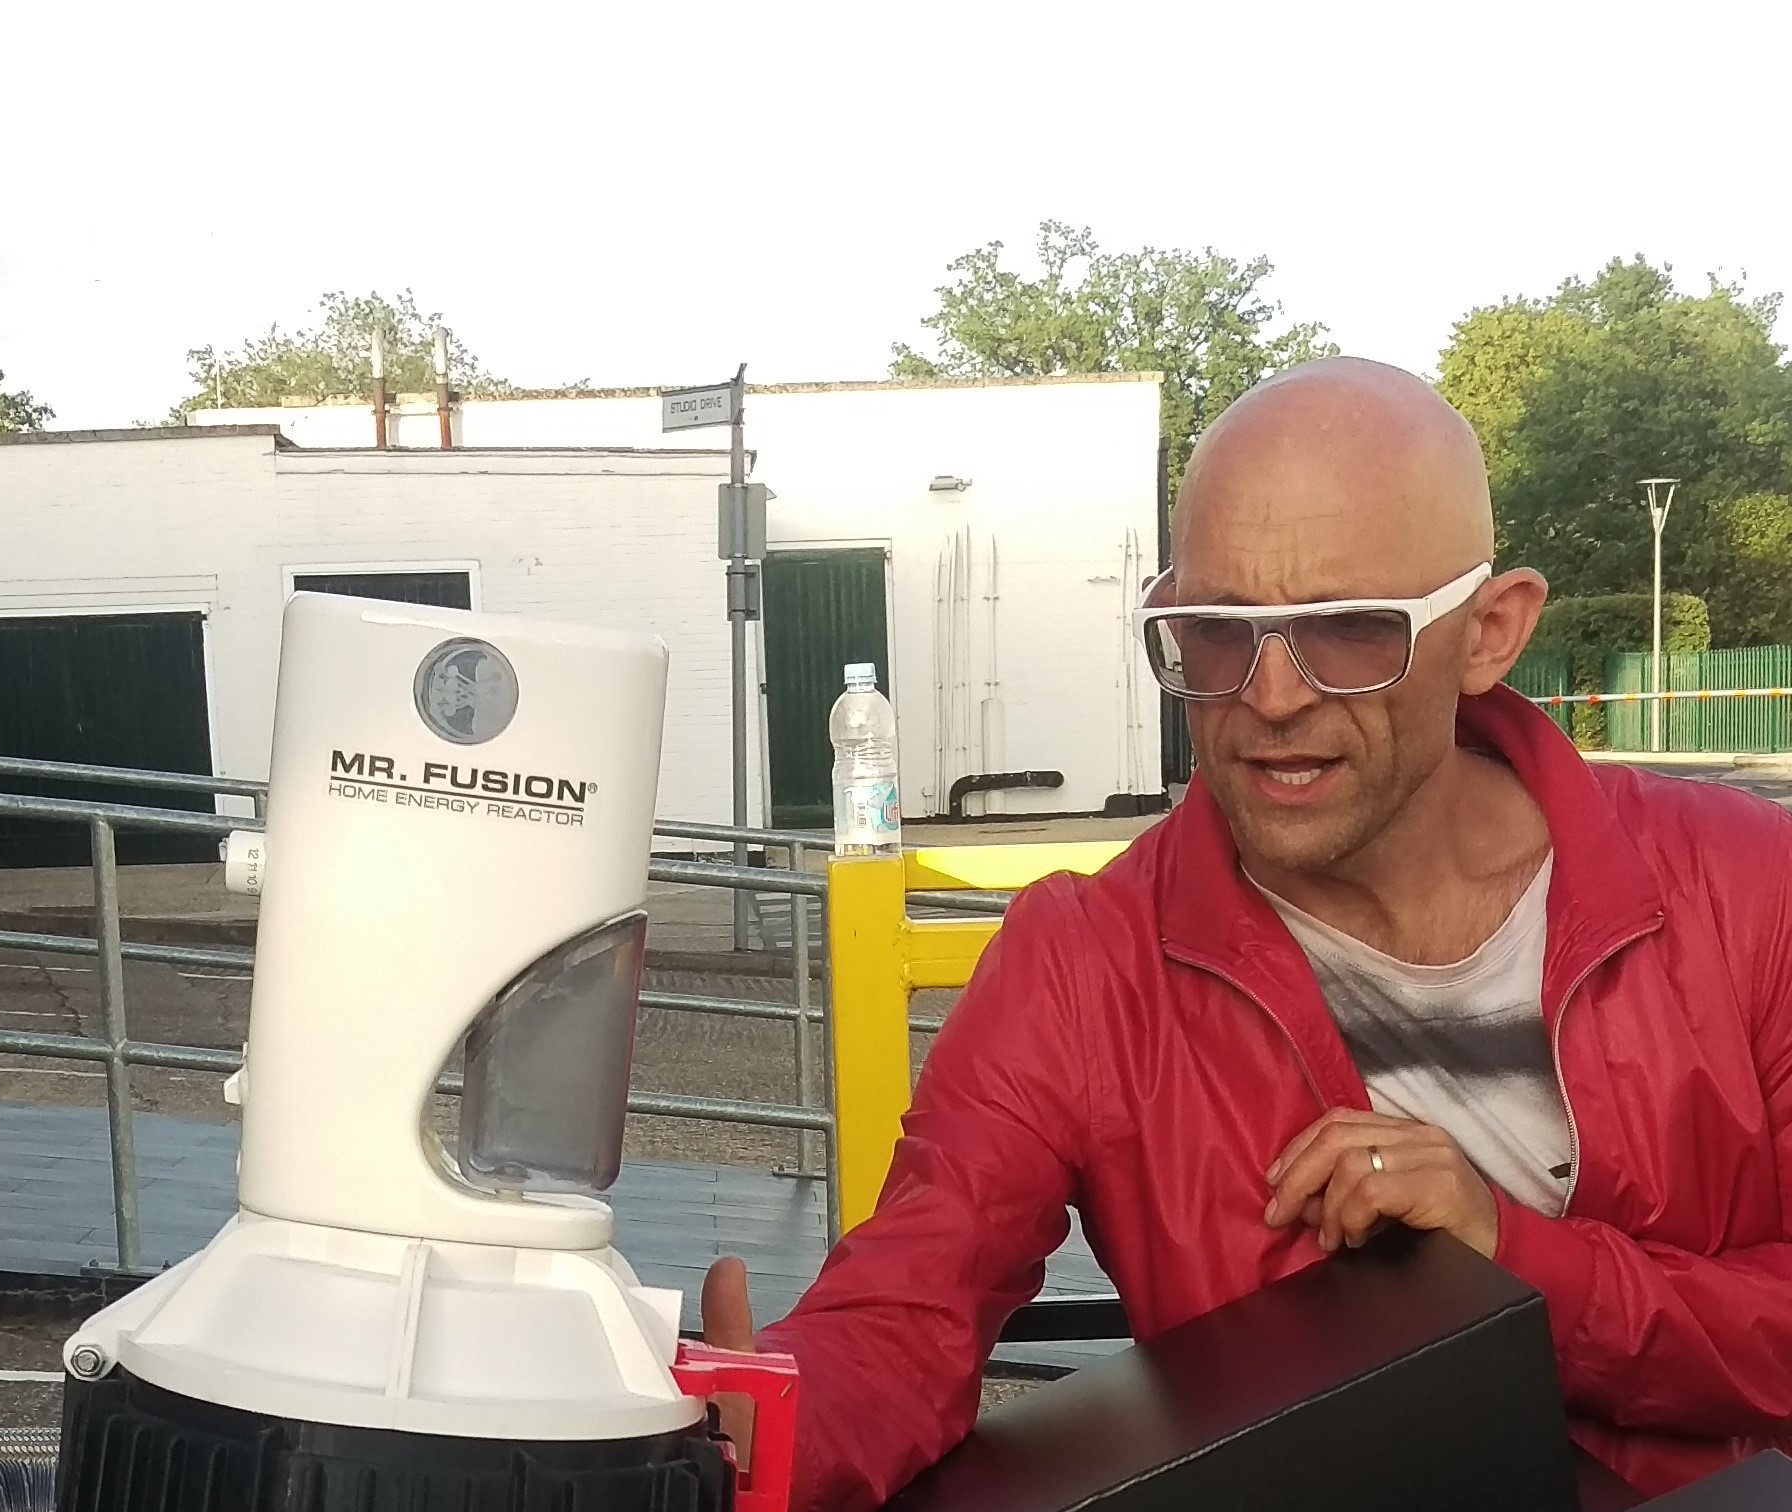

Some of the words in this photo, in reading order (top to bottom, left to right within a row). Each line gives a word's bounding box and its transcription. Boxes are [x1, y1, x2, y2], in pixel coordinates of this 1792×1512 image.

[670, 400, 696, 414] STUDIO
[700, 396, 722, 410] DRIVE
[330, 749, 407, 782] MR.
[328, 783, 388, 803] HOME
[395, 791, 480, 815] ENERGY
[486, 804, 584, 827] REACTOR
[247, 848, 259, 860] 12
[247, 875, 258, 886] 10
